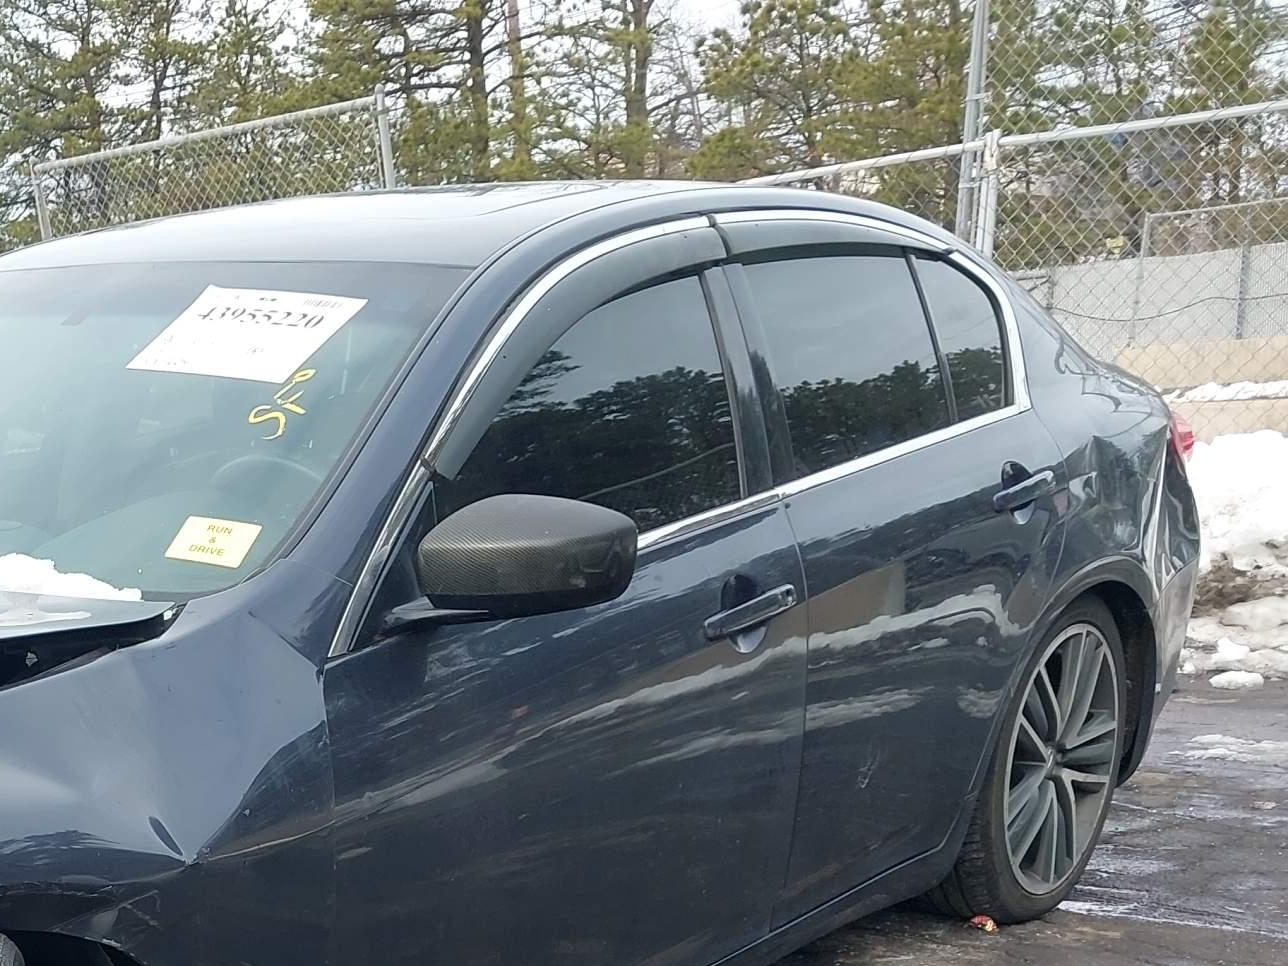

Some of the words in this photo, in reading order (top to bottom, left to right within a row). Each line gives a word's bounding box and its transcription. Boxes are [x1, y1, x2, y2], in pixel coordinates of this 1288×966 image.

[198, 305, 325, 329] 43955220
[206, 524, 234, 535] RUN
[208, 536, 217, 544] &
[188, 544, 225, 557] DRIVE
